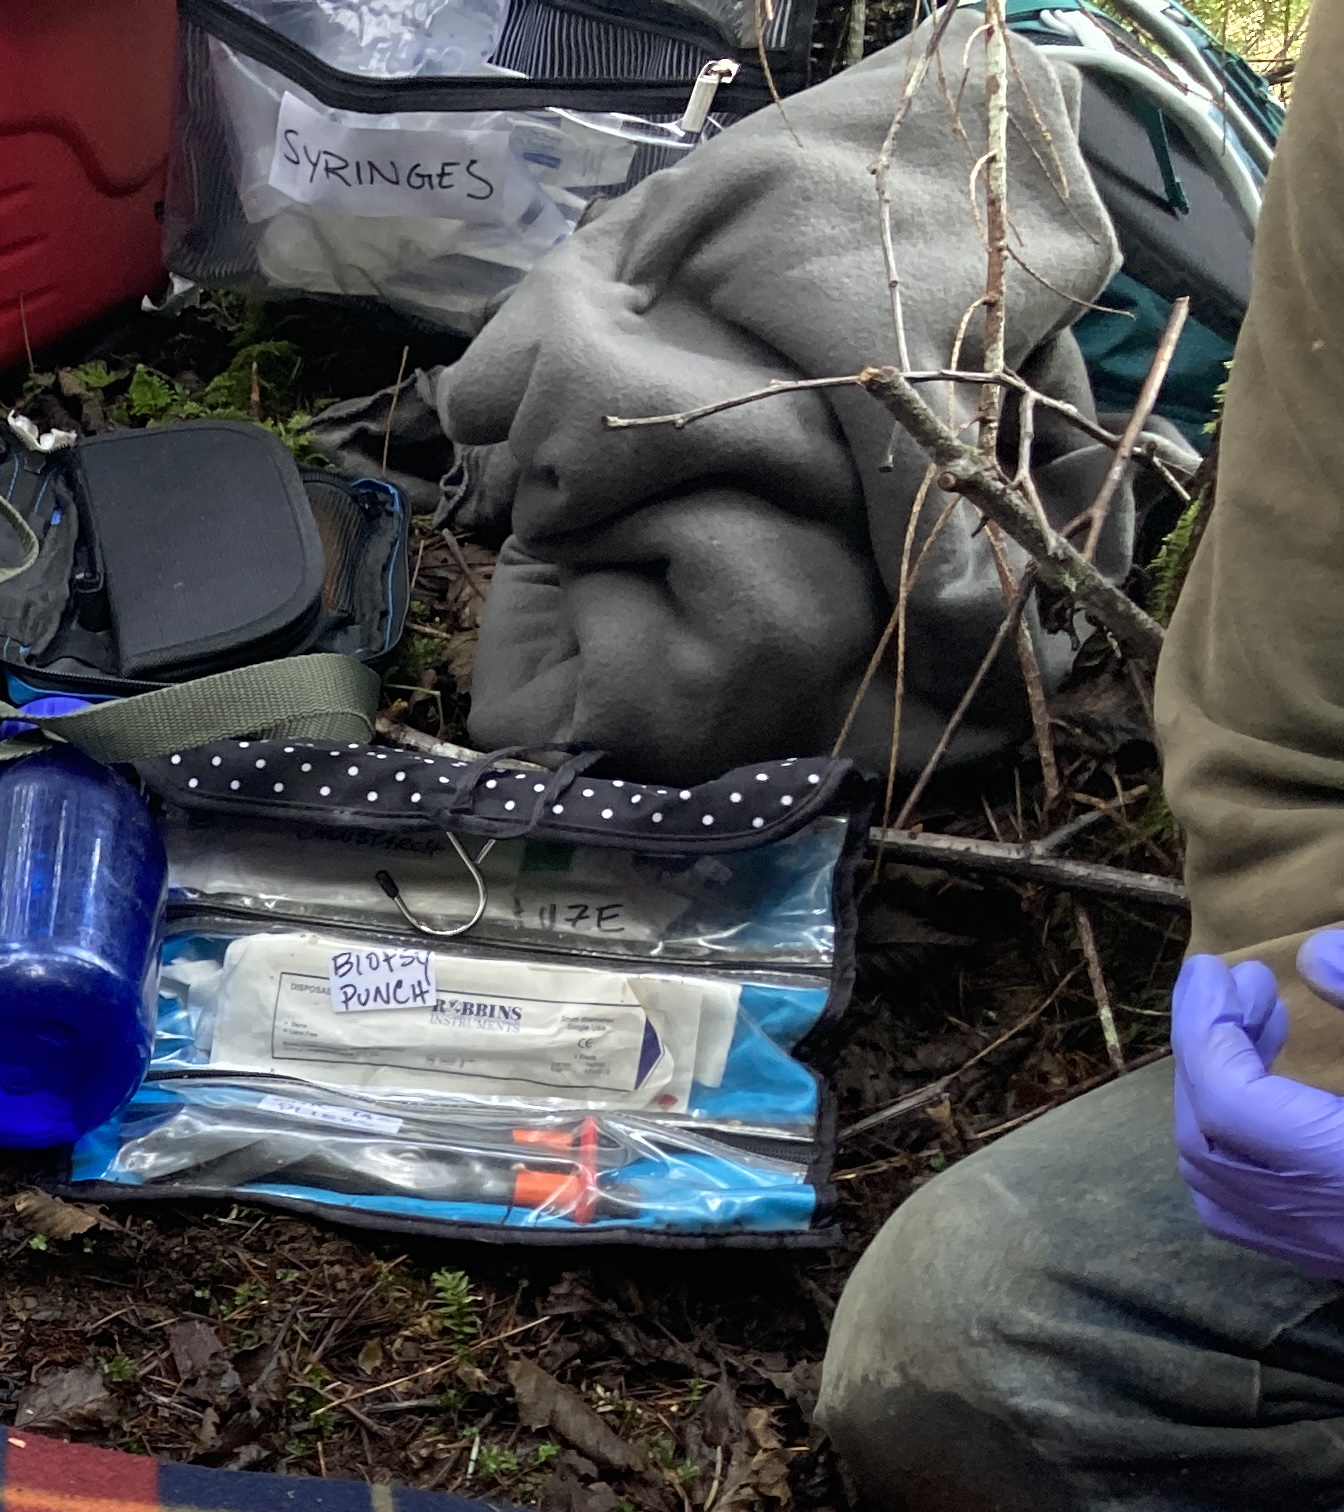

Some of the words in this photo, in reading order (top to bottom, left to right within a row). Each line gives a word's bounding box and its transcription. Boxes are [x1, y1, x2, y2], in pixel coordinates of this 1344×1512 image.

[283, 128, 494, 200] SYRINGES
[340, 979, 431, 1010] PUNCH
[429, 1012, 521, 1033] INSTRUMENTS
